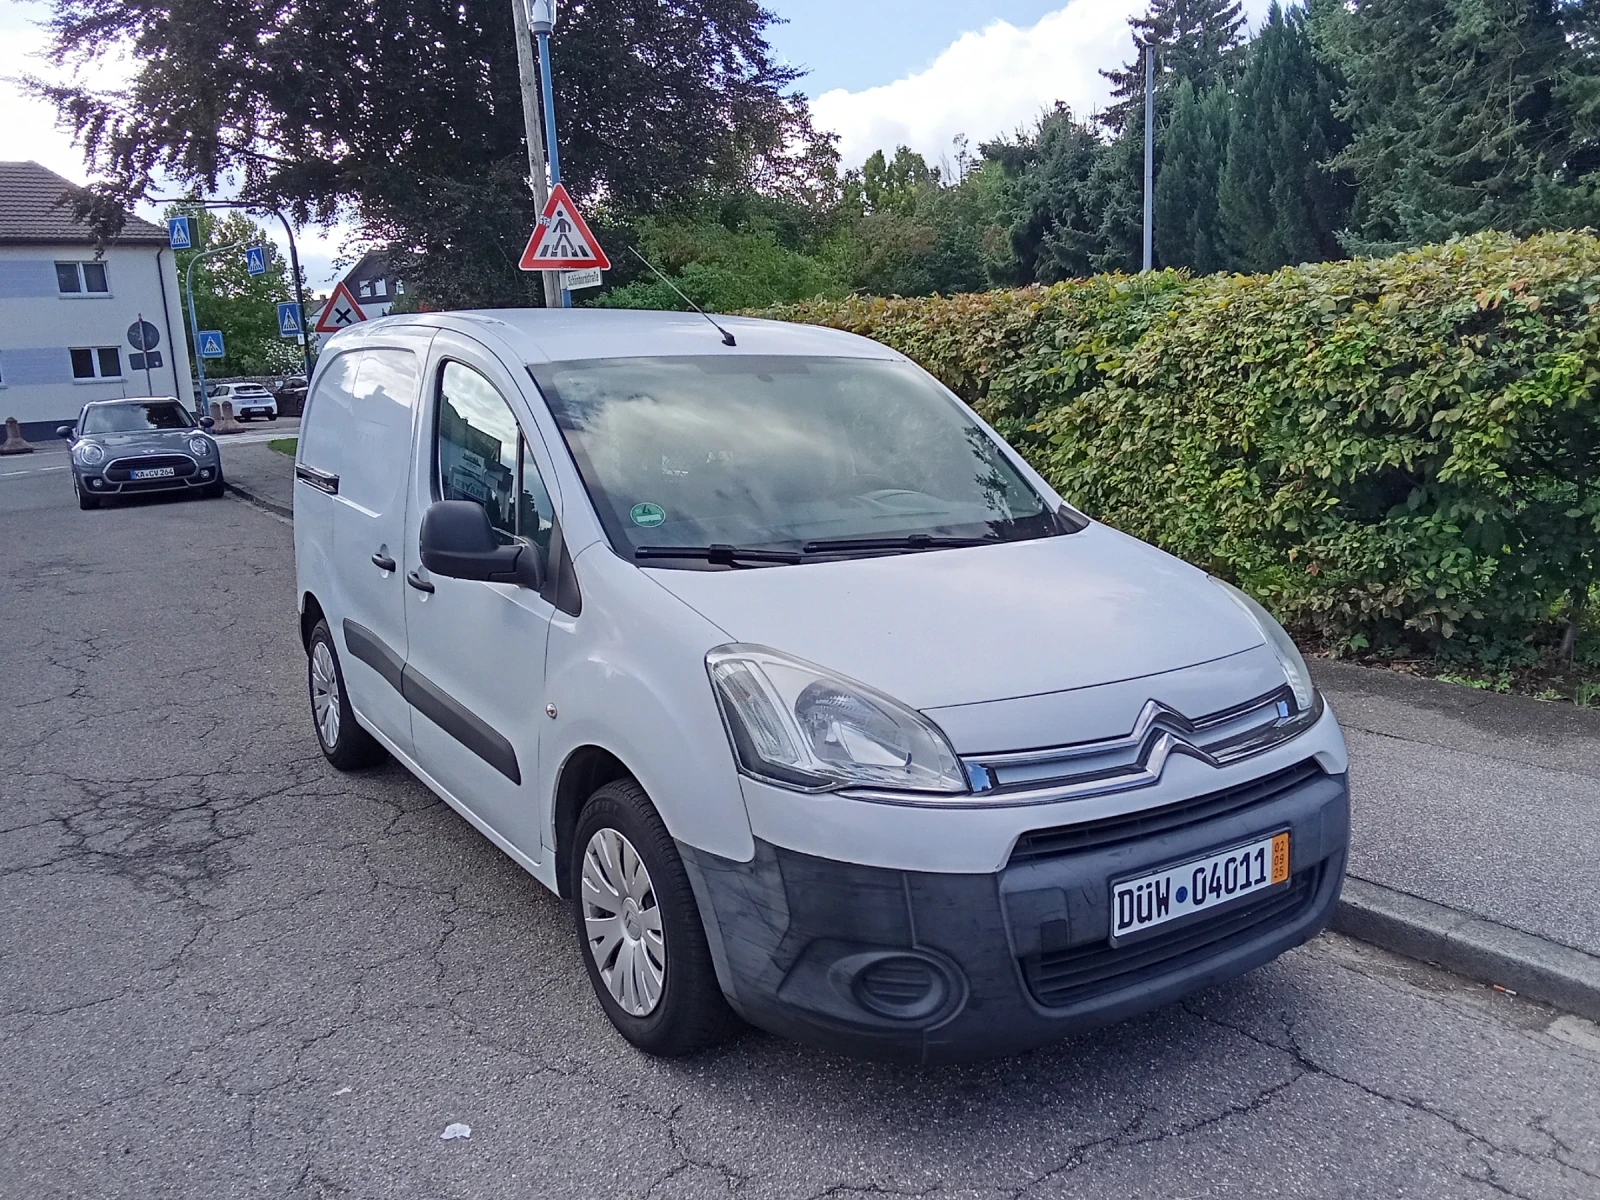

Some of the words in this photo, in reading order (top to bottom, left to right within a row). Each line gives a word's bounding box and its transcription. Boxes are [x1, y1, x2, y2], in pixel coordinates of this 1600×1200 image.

[160, 468, 174, 476] 264
[642, 504, 652, 515] 4
[1274, 840, 1285, 853] 02
[1273, 853, 1285, 866] 09
[1191, 846, 1267, 906] 04011
[1273, 866, 1284, 879] 25
